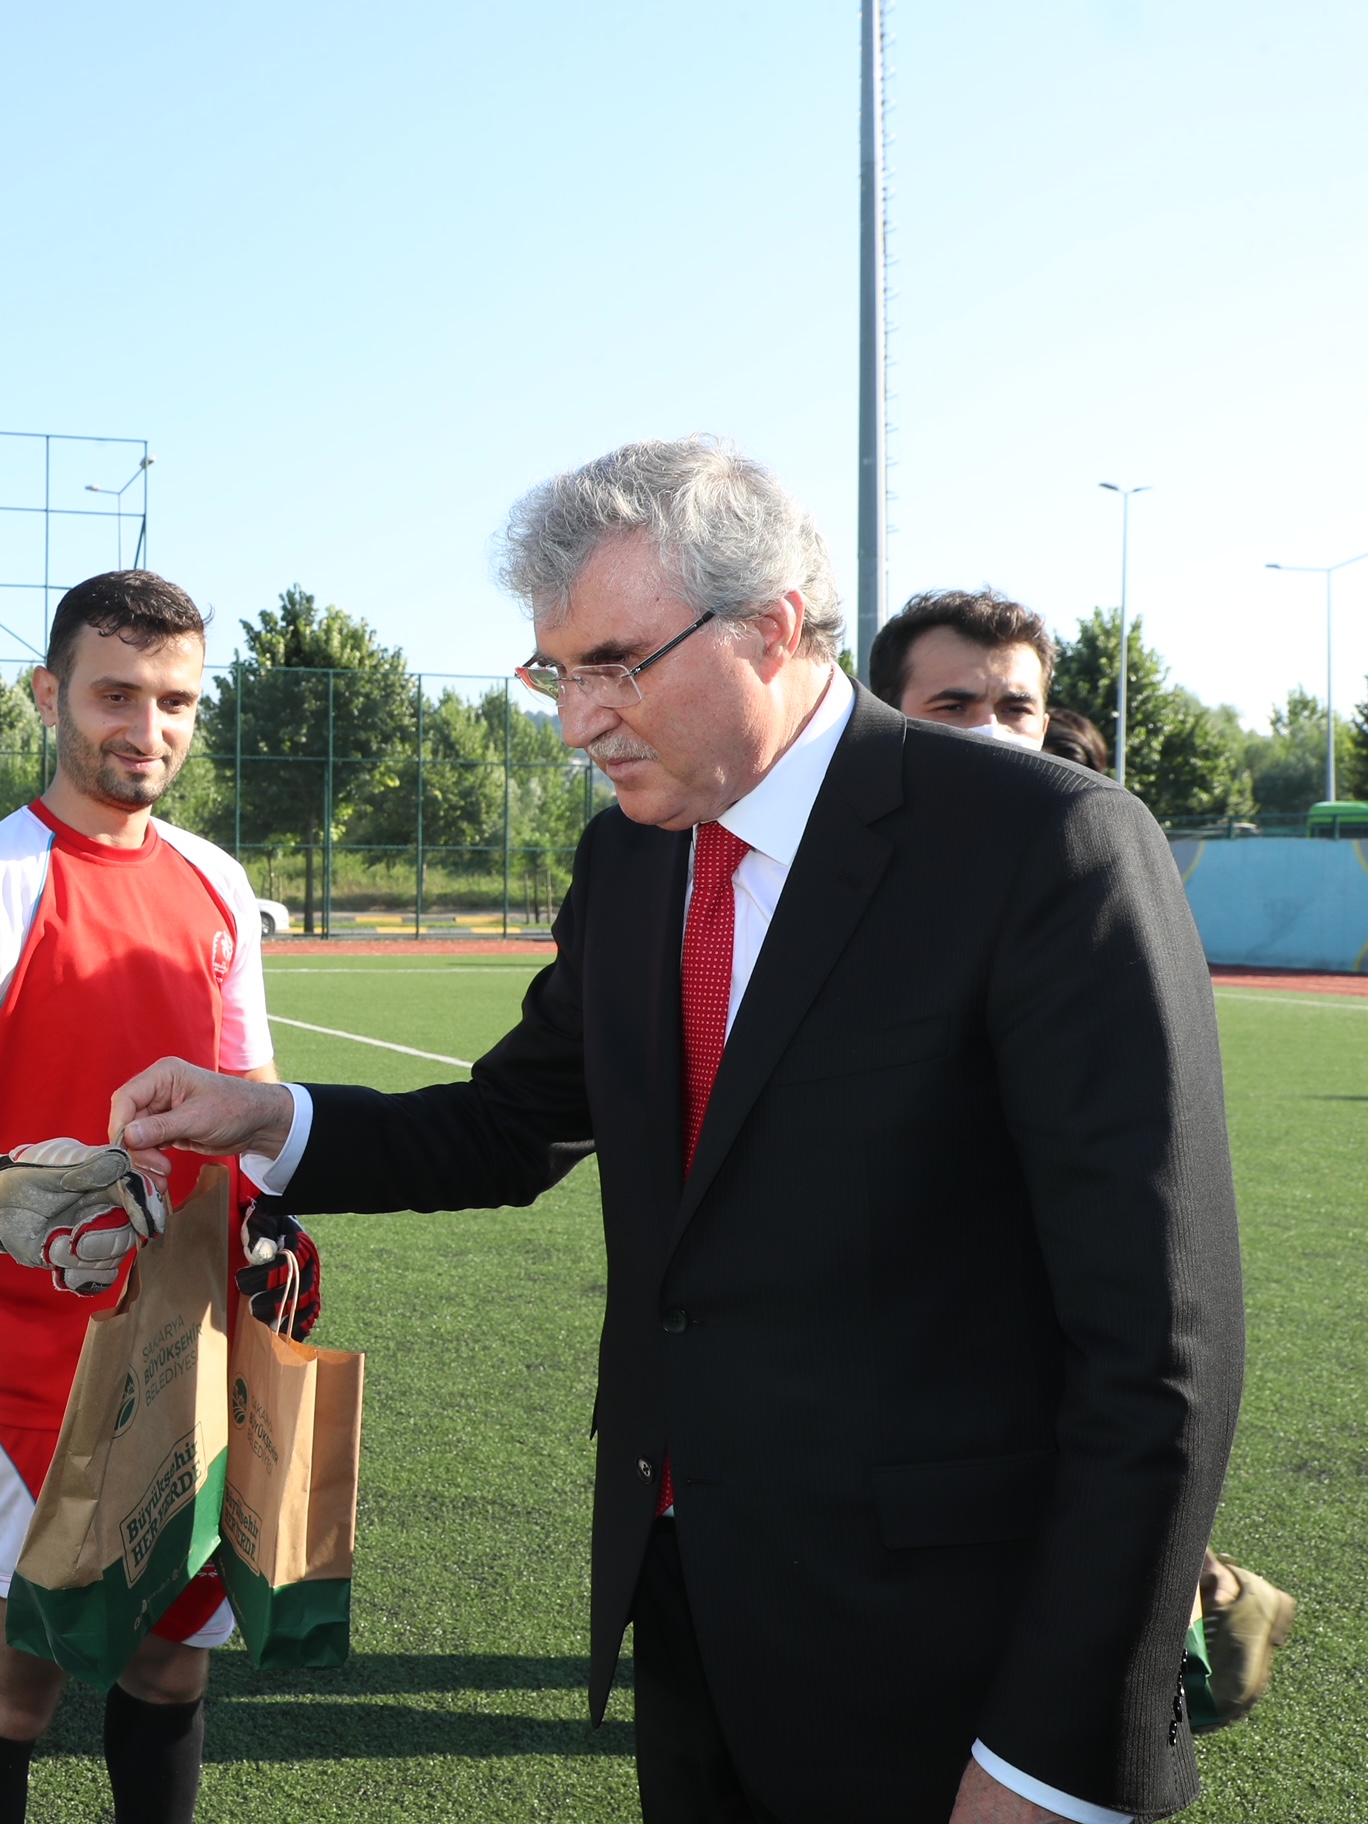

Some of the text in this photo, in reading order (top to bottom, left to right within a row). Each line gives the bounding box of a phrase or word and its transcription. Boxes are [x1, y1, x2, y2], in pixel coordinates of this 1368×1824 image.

[142, 1314, 185, 1363] SAKARYA
[144, 1322, 203, 1386] BÜYÜKŞEHİR
[131, 1517, 159, 1569] HER
